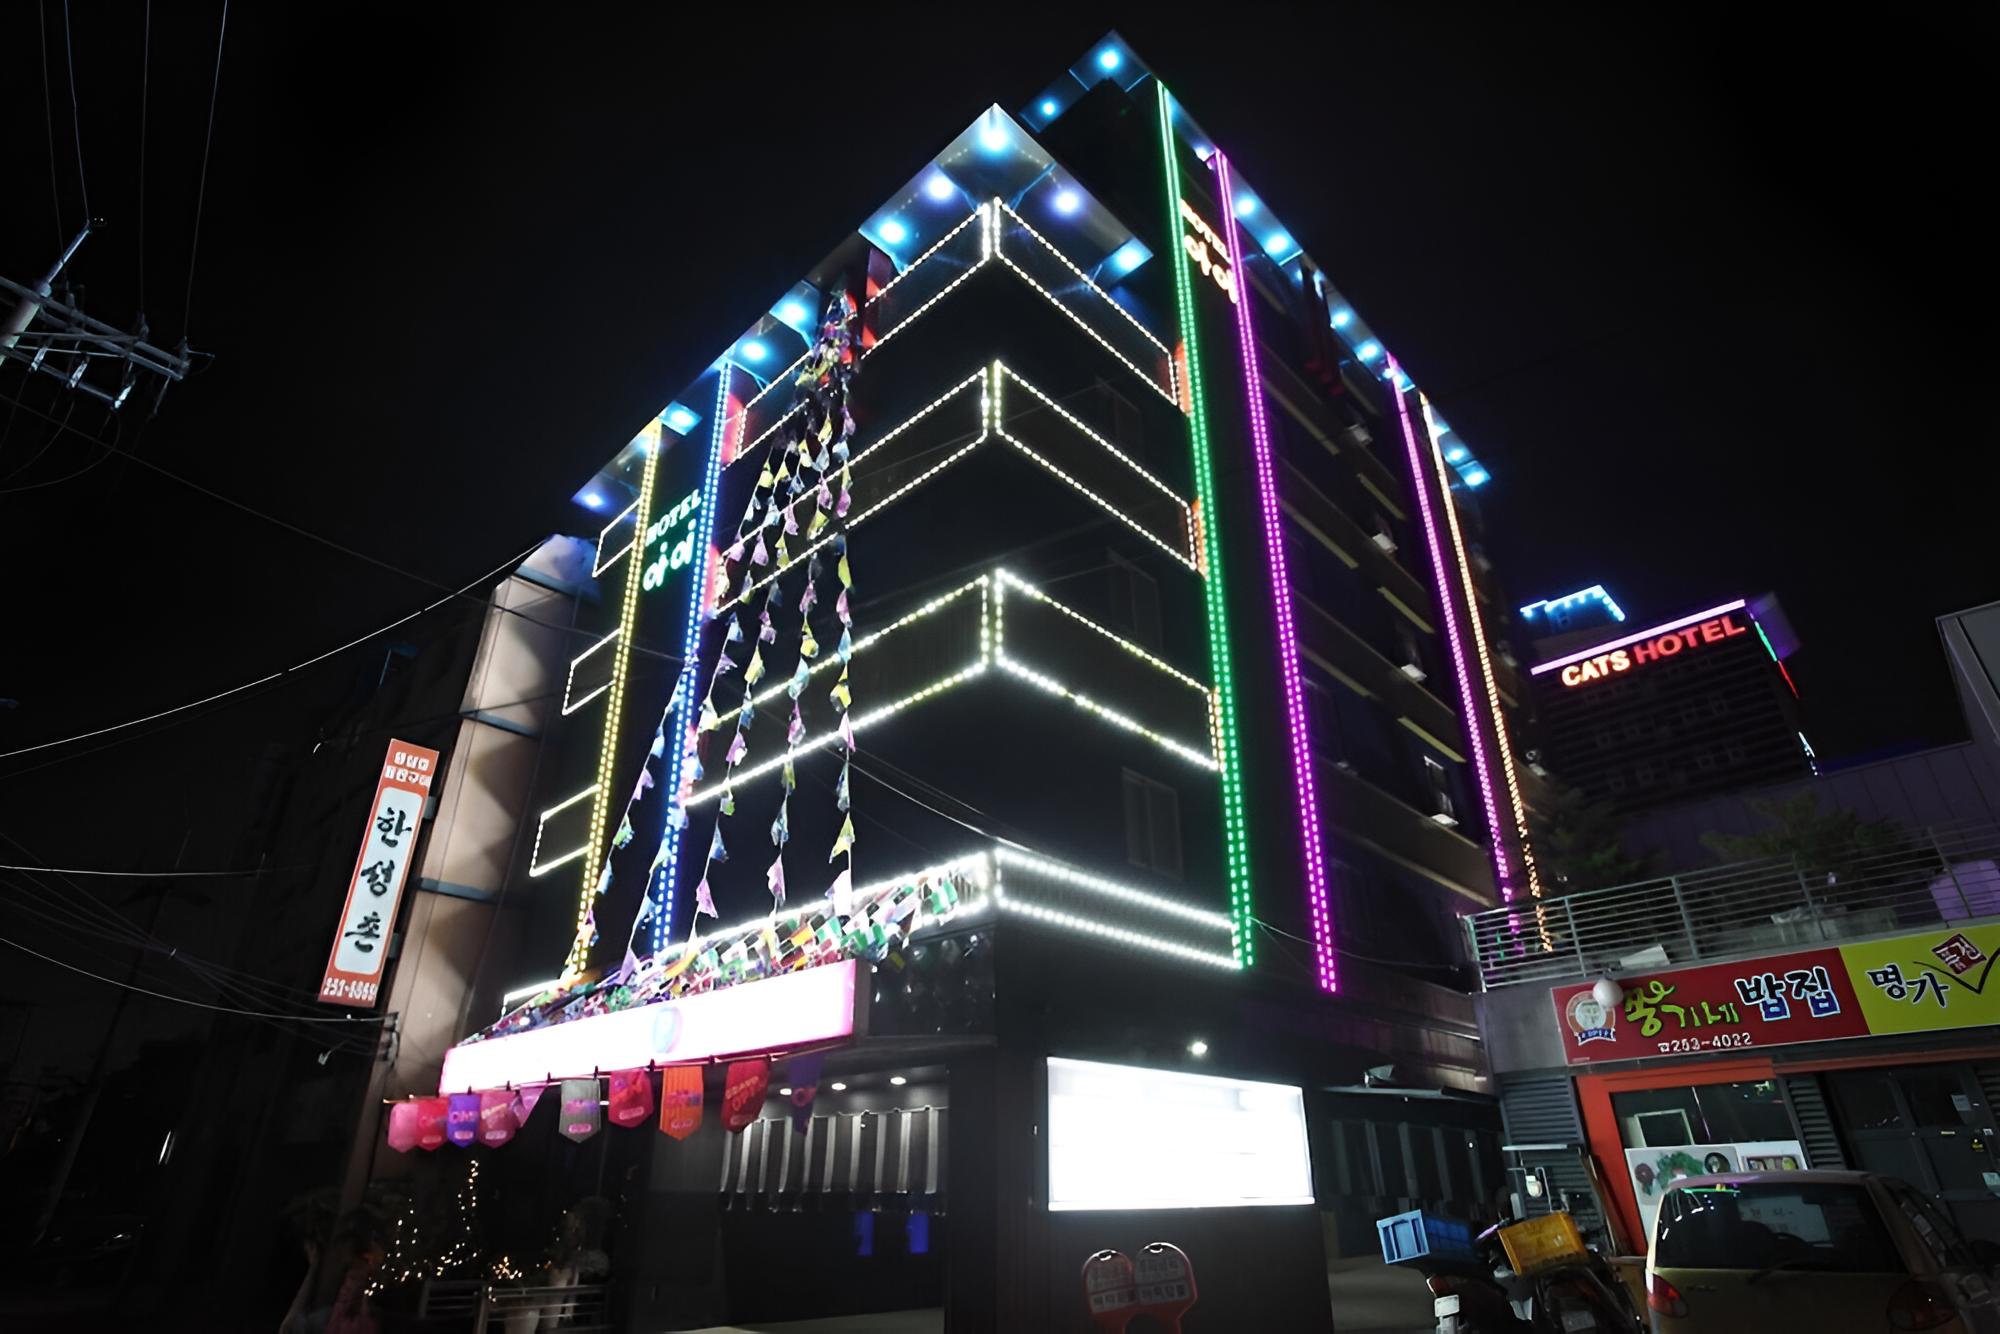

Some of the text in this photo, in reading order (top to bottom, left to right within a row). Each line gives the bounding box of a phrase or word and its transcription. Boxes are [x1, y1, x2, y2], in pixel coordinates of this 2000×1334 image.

[1561, 614, 1746, 688] CATS HOTEL
[1734, 965, 1841, 1021] 밥집
[1866, 962, 1951, 1010] 명가
